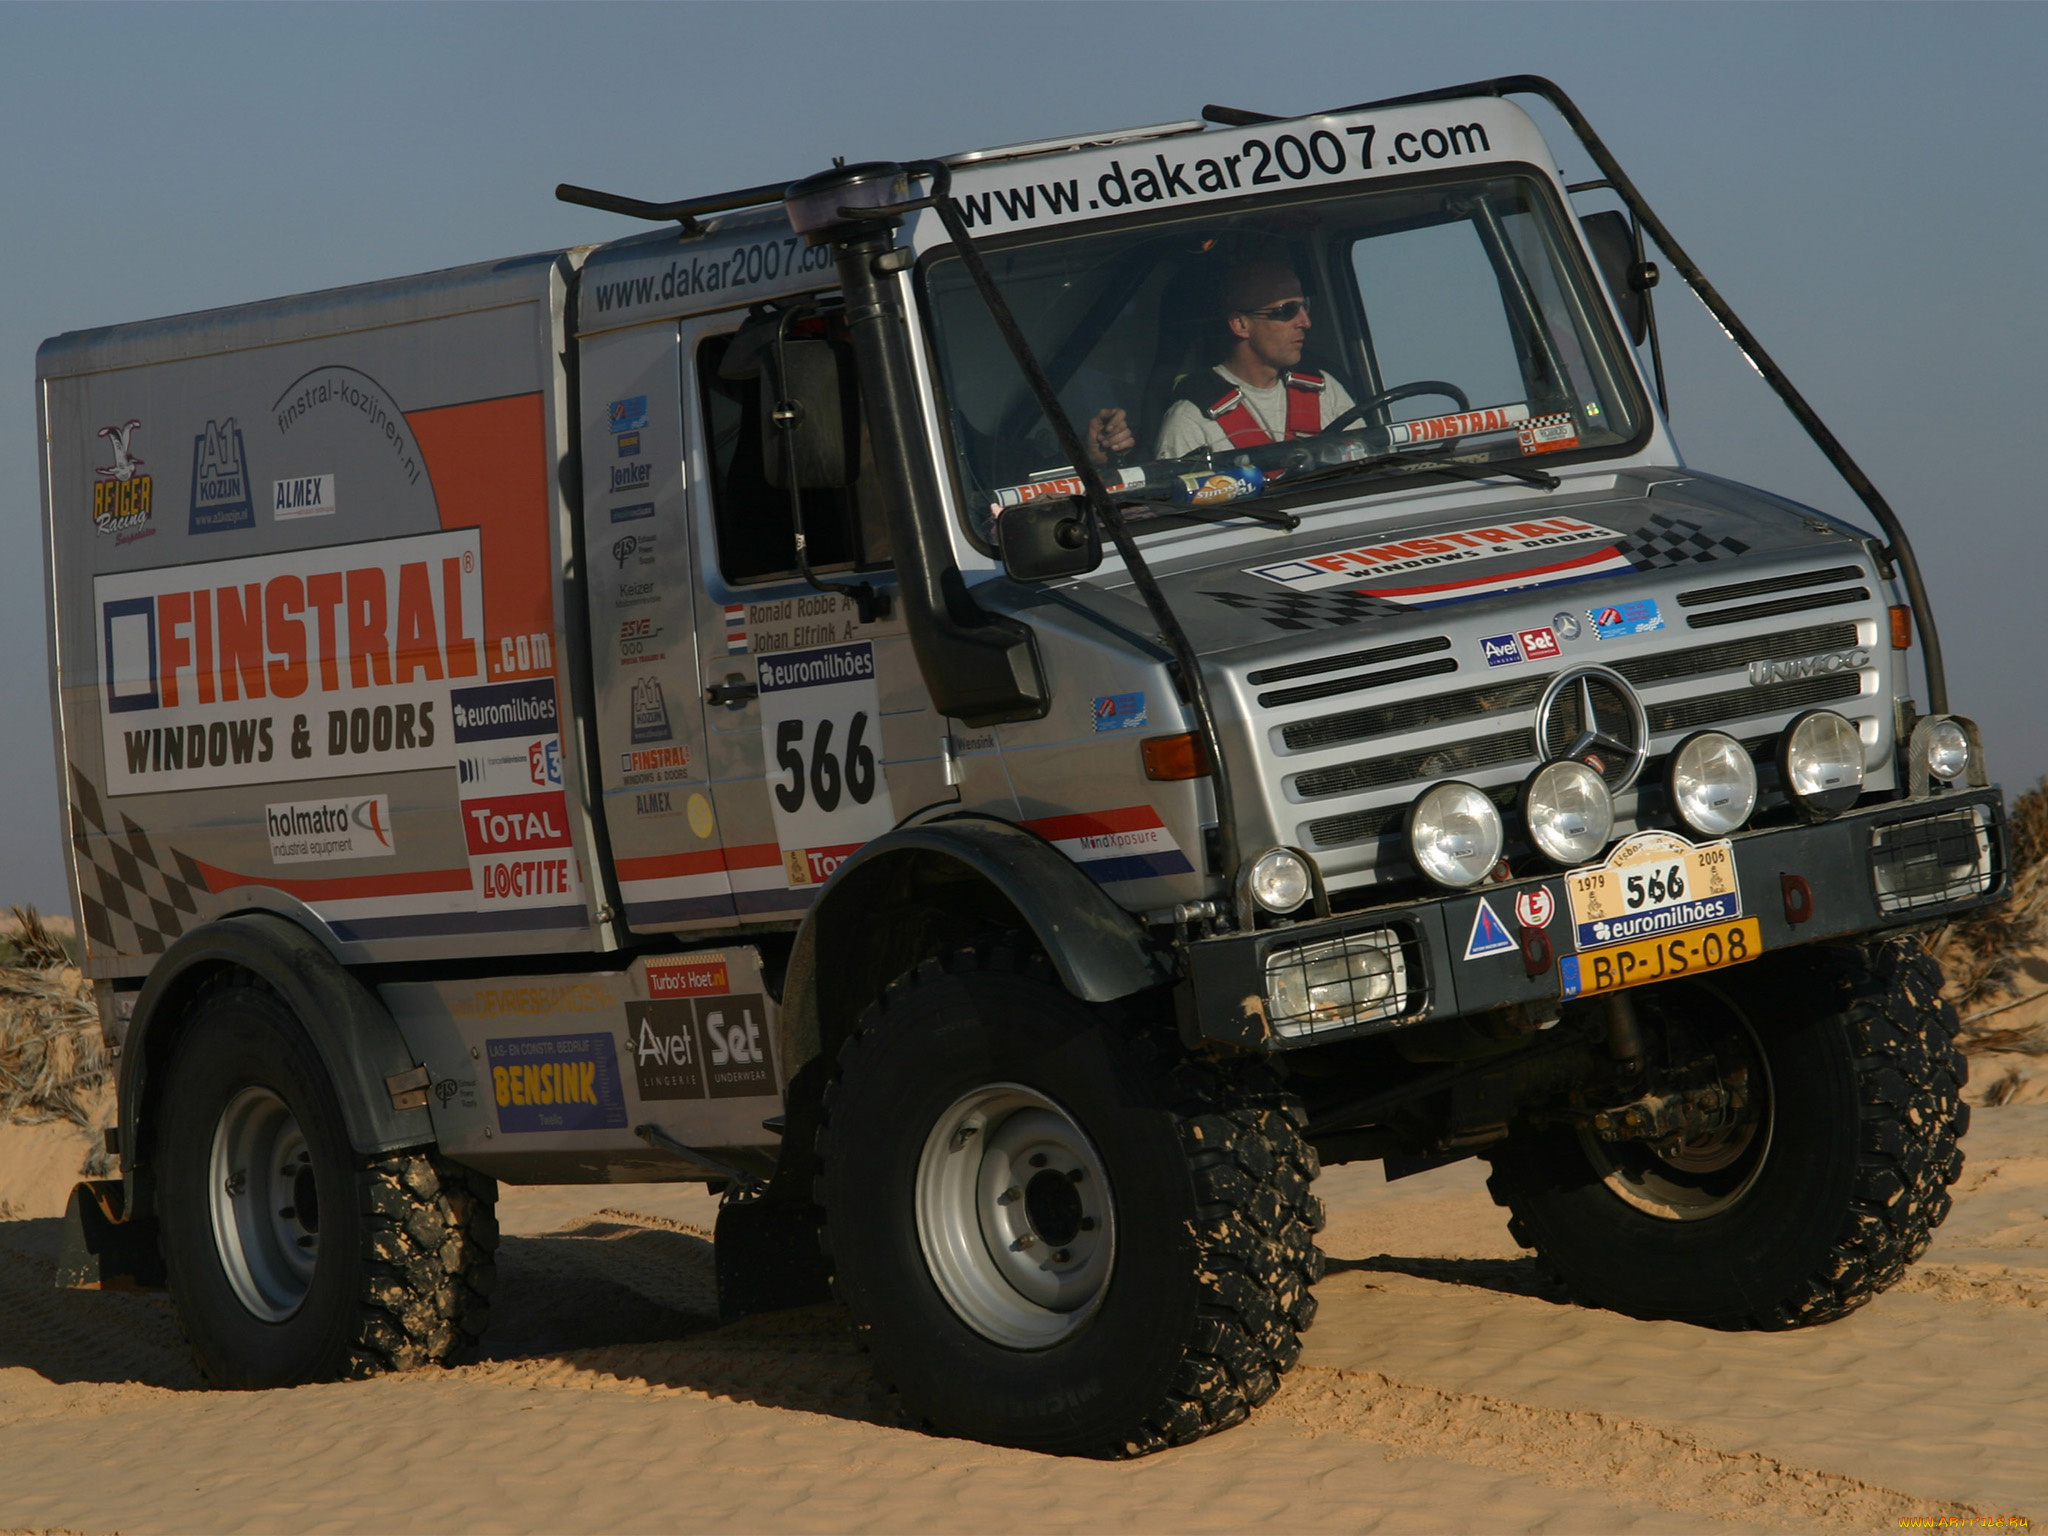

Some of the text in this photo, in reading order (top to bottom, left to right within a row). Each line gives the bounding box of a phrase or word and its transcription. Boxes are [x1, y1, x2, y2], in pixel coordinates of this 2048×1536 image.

[950, 122, 1491, 230] www.dakar2007.com
[597, 238, 840, 312] www.dakar2007.co
[278, 379, 420, 485] finstral-kozijnen.nl
[1409, 409, 1510, 442] FINSTRAL
[201, 417, 239, 478] A1
[201, 478, 240, 500] KOZIJN
[276, 478, 322, 509] ALMEX
[97, 511, 147, 536] Racing
[1305, 520, 1595, 571] FINSTRAL
[1345, 530, 1610, 578] WINDOWS & DOORS
[620, 582, 655, 597] Keizer
[750, 600, 792, 625] Ronald
[798, 596, 836, 616] Robbe
[495, 632, 552, 673] .com
[753, 630, 789, 652] Johan
[794, 624, 835, 648] Elfrink
[1485, 641, 1518, 658] Avet
[1524, 631, 1554, 651] Set
[776, 651, 872, 685] euromilhões
[1749, 648, 1870, 687] UNIMOG
[634, 676, 661, 712] A1
[469, 697, 555, 728] euromilhões
[124, 701, 435, 774] WINDOWS & DOORS
[632, 747, 686, 771] FINSTRAL
[775, 711, 875, 813] 566
[623, 774, 655, 787] WINDOWS
[665, 768, 688, 782] DOORS
[637, 792, 672, 815] ALMEX
[273, 838, 353, 857] industrial equipment
[1081, 831, 1158, 850] MindXposure
[484, 859, 568, 898] LOCTITE
[1578, 875, 1605, 891] 1979
[1627, 865, 1684, 909] 566
[1529, 891, 1543, 915] E
[1611, 900, 1725, 938] euromilhões
[1593, 927, 1748, 990] BP-JS-08
[651, 968, 726, 990] Turbo's Hoet.nl
[639, 1017, 693, 1067] Avet
[707, 1009, 764, 1067] Set
[493, 1061, 598, 1107] BENSINK
[644, 1074, 697, 1088] LINGERIE
[714, 1070, 767, 1085] UNDERWEAR
